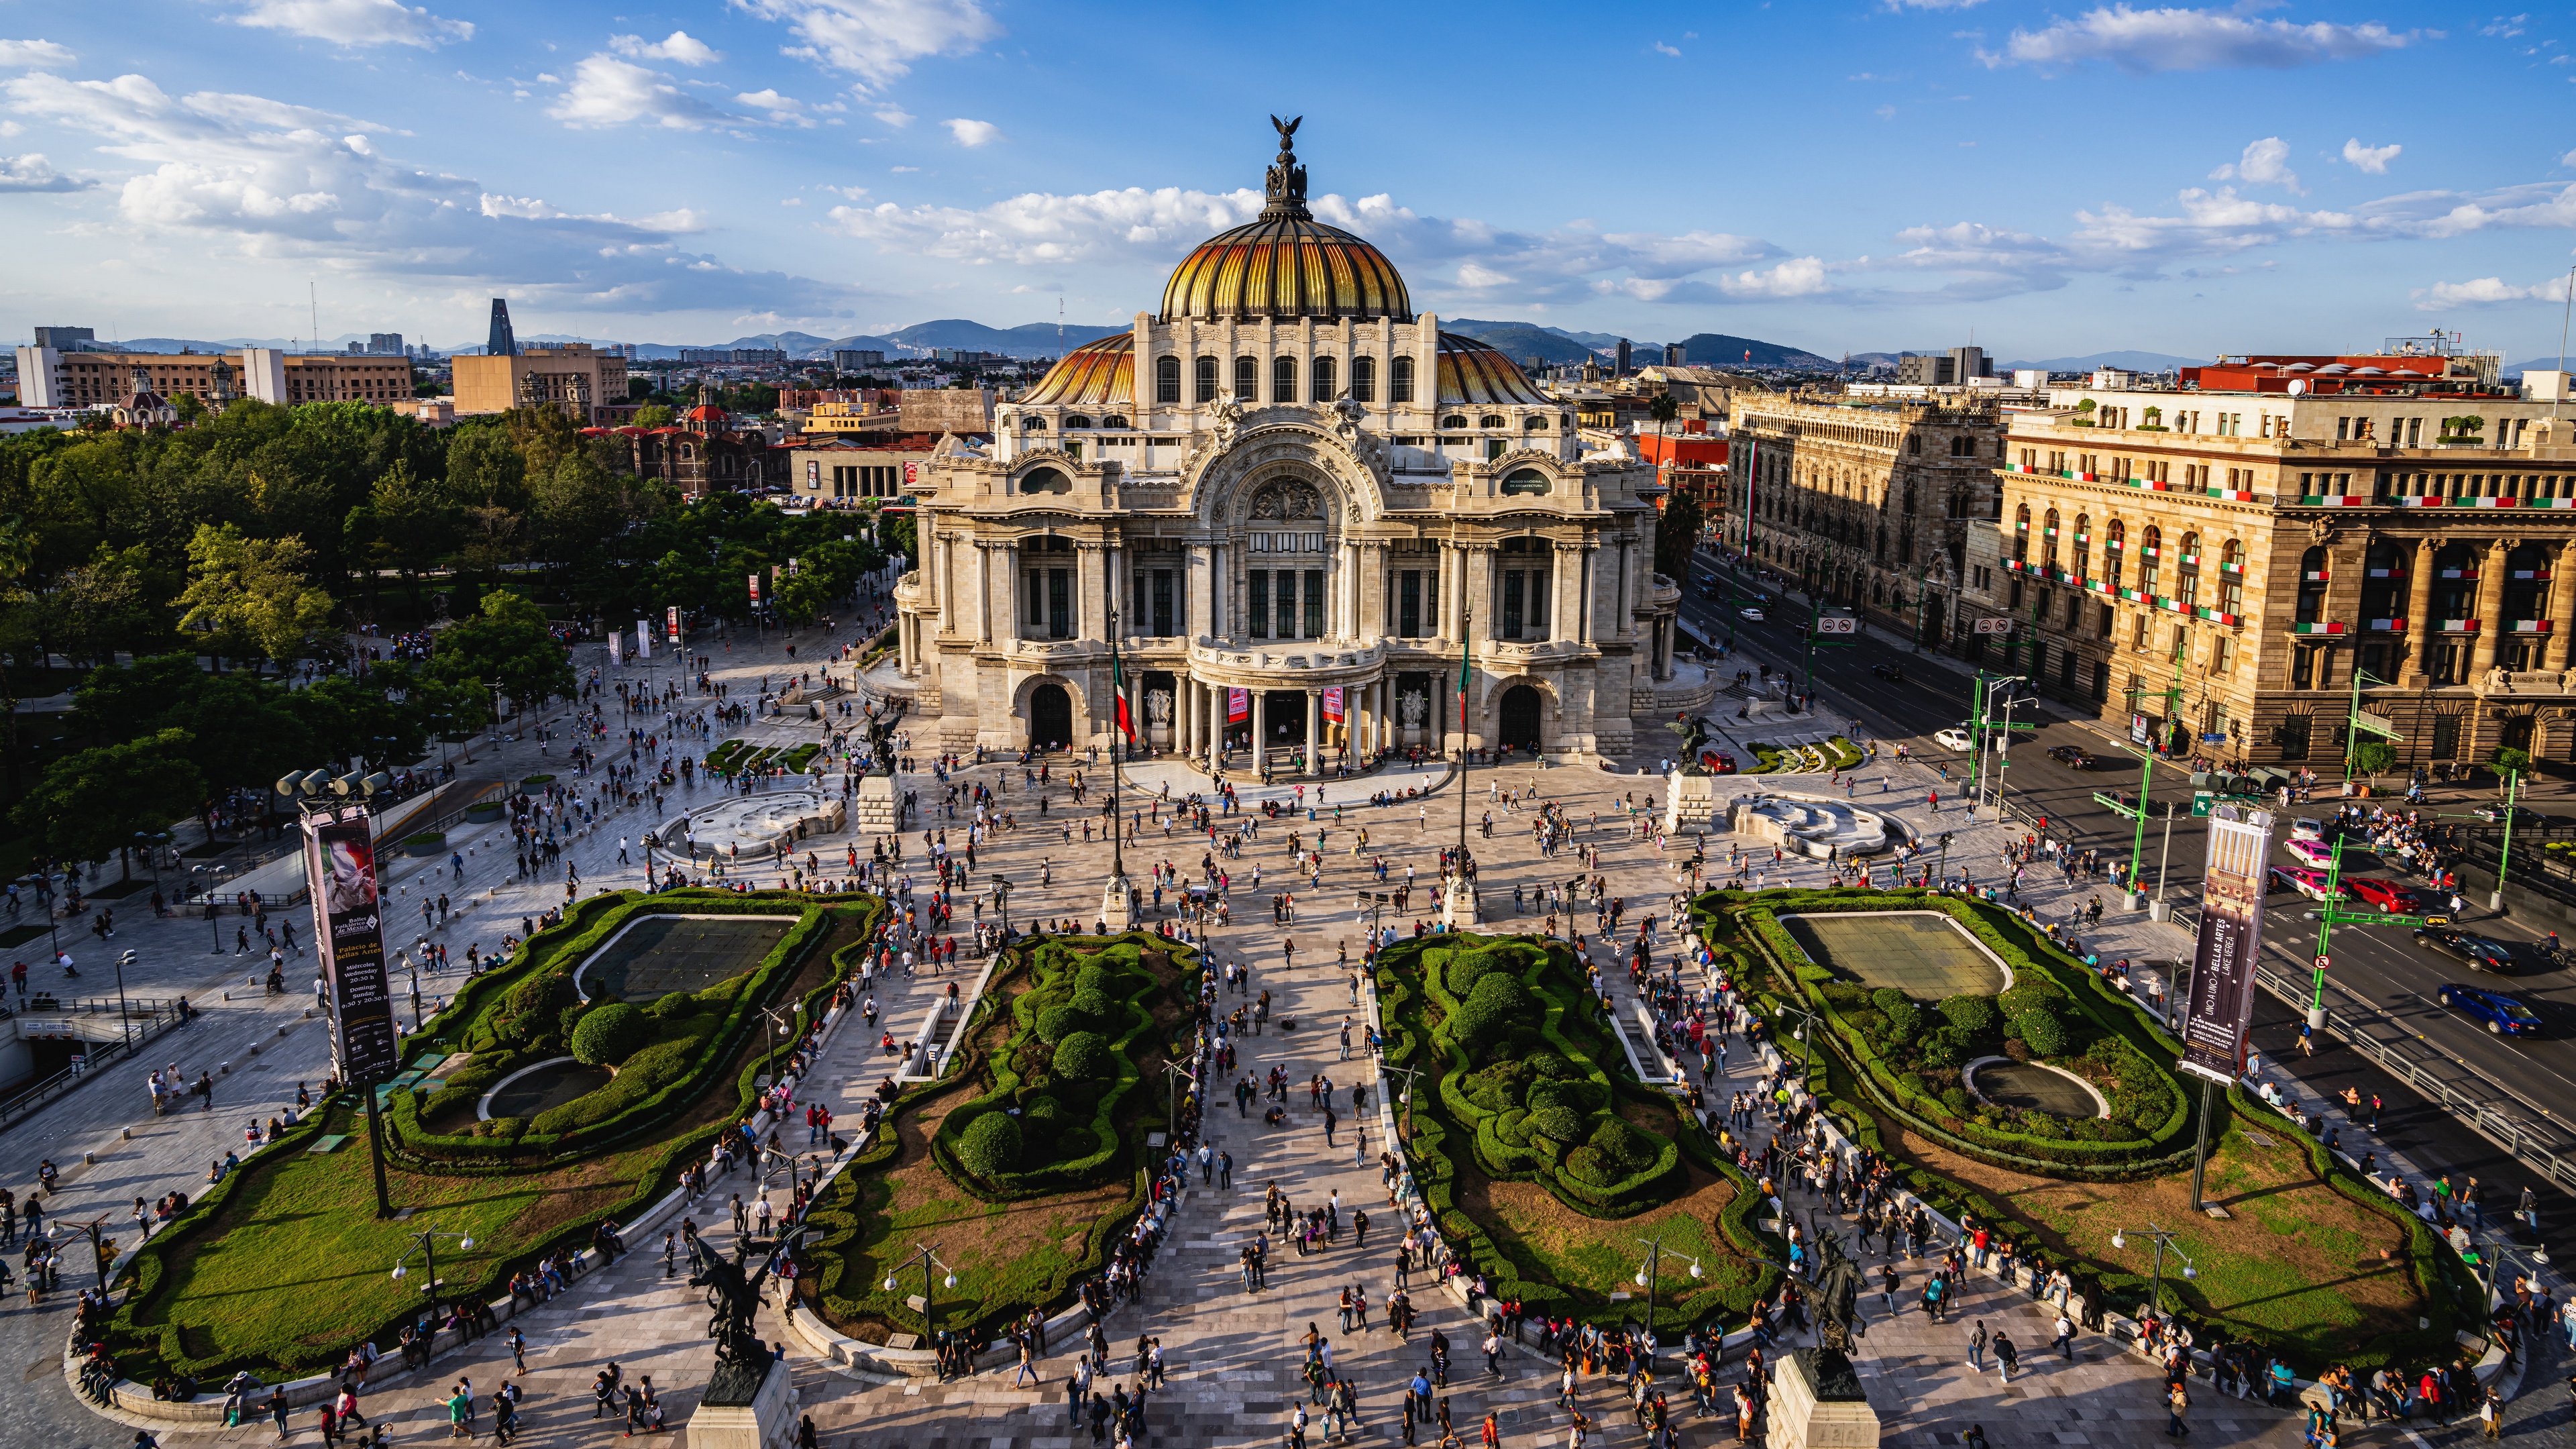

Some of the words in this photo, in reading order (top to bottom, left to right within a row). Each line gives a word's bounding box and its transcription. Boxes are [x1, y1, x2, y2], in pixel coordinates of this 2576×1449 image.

[1236, 477, 1259, 516] PALACIO
[1262, 469, 1275, 479] DE
[1281, 466, 1320, 483] BELLAS
[1320, 486, 1338, 516] ARTES
[335, 922, 366, 930] Folklórico
[2216, 918, 2226, 943] ARTES
[339, 945, 366, 953] Palacio
[2225, 936, 2235, 957] VEREA
[336, 952, 359, 961] Bellas
[362, 947, 382, 955] Artes
[2211, 944, 2223, 972] BELLAS
[344, 968, 378, 978] Wednesday
[346, 962, 375, 971] Miércoles
[2222, 957, 2231, 976] LAKE
[350, 984, 377, 994] Domingo
[2209, 978, 2218, 994] UNO
[352, 991, 376, 999] Sunday
[341, 1001, 356, 1010] 9:30
[364, 996, 382, 1004] 20:30
[2205, 1000, 2214, 1016] UNO
[2205, 1021, 2234, 1034] septiembre
[2208, 1027, 2235, 1040] noviembre
[2200, 1036, 2215, 1044] BELLAS
[2214, 1036, 2233, 1046] PALACIO
[928, 1051, 936, 1061] E
